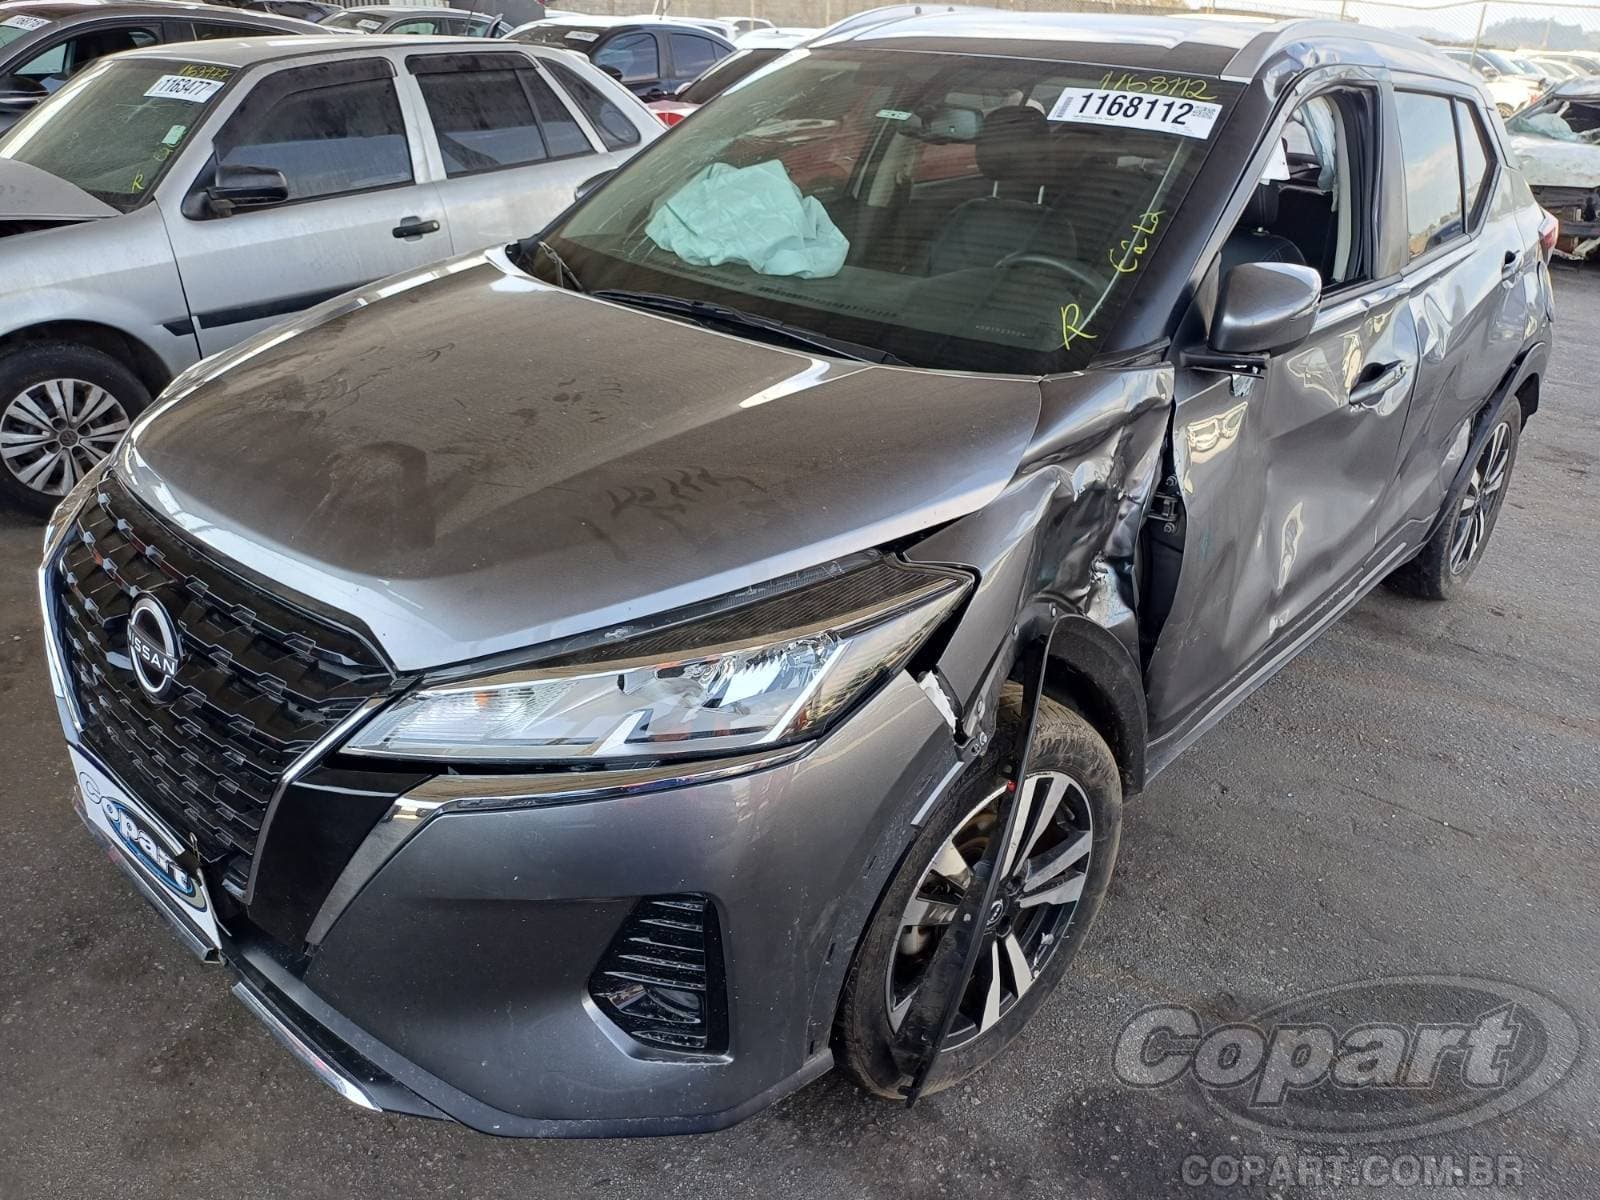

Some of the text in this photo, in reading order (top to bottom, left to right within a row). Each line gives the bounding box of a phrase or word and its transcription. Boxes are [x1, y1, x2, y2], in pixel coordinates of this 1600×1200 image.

[159, 78, 212, 96] 1163477
[1099, 70, 1217, 100] 1168112
[1077, 92, 1195, 126] 1168112
[1061, 303, 1098, 350] R
[79, 771, 191, 894] Copart
